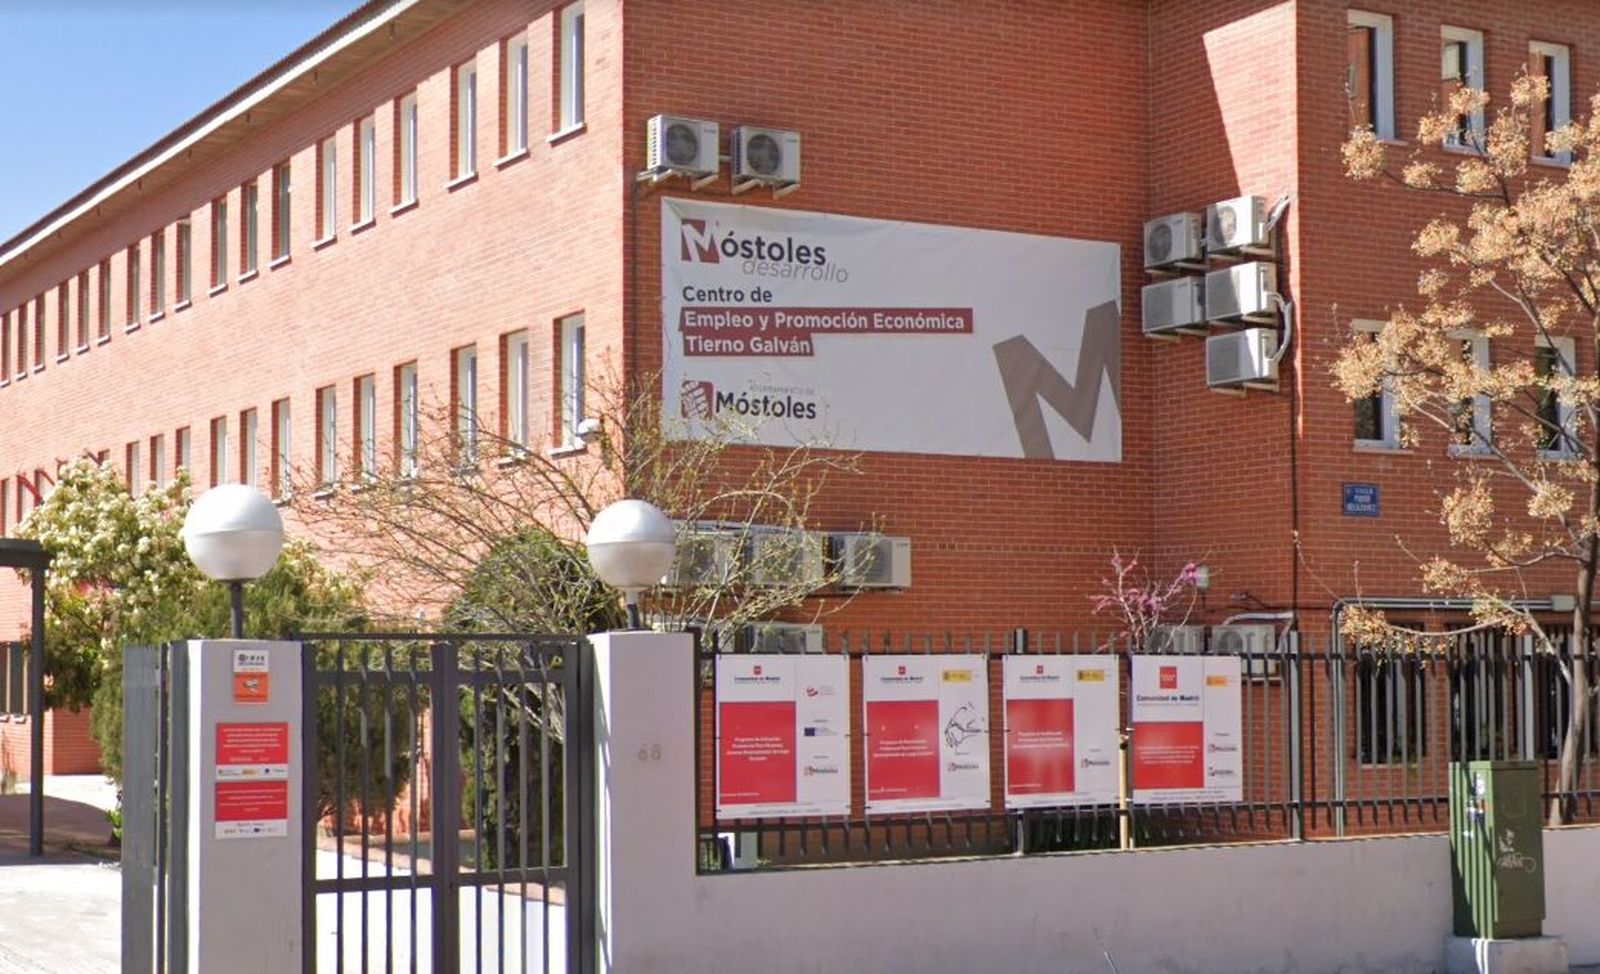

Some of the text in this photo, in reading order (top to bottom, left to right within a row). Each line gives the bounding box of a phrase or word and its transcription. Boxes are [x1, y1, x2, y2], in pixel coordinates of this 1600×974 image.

[742, 257, 849, 284] desarrollo
[682, 286, 773, 302] Centro de
[684, 310, 965, 331] Empleo y Promoción Económica
[685, 335, 810, 354] Tierno Galván
[715, 391, 817, 420] Móstoles
